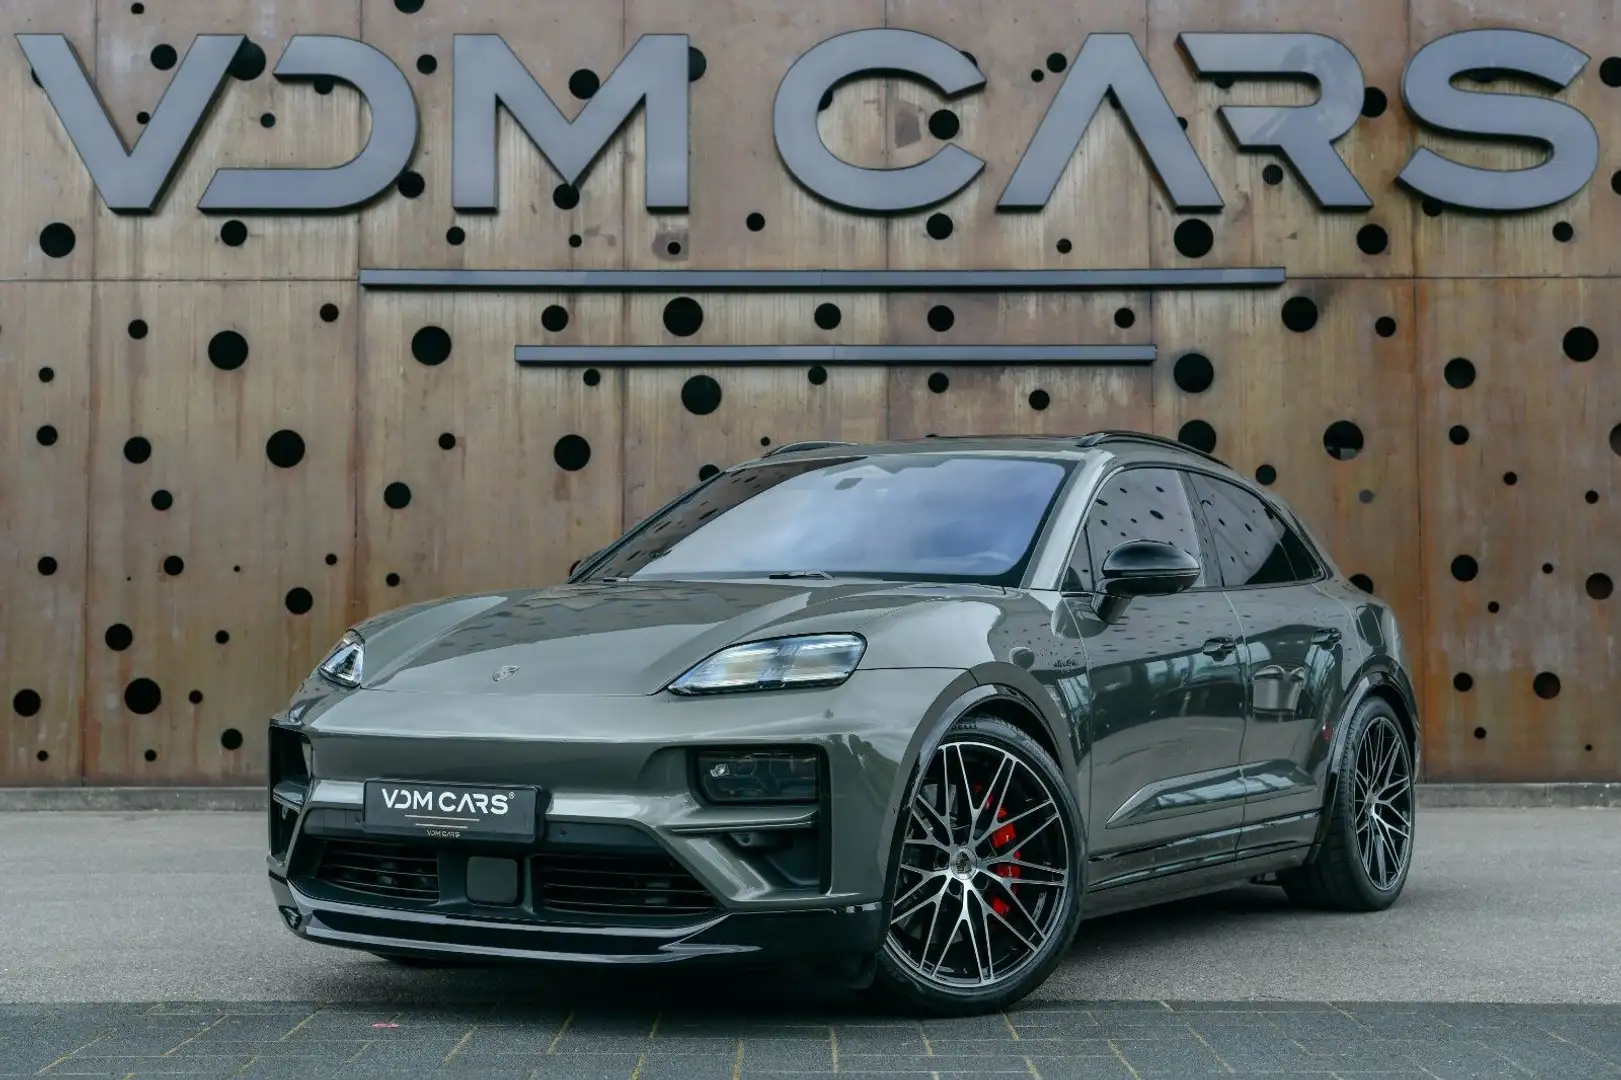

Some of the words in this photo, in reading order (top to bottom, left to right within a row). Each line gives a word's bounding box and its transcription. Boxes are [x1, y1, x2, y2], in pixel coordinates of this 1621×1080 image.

[15, 33, 690, 212] VDM
[774, 28, 1596, 212] CARS
[381, 788, 433, 811] VDM
